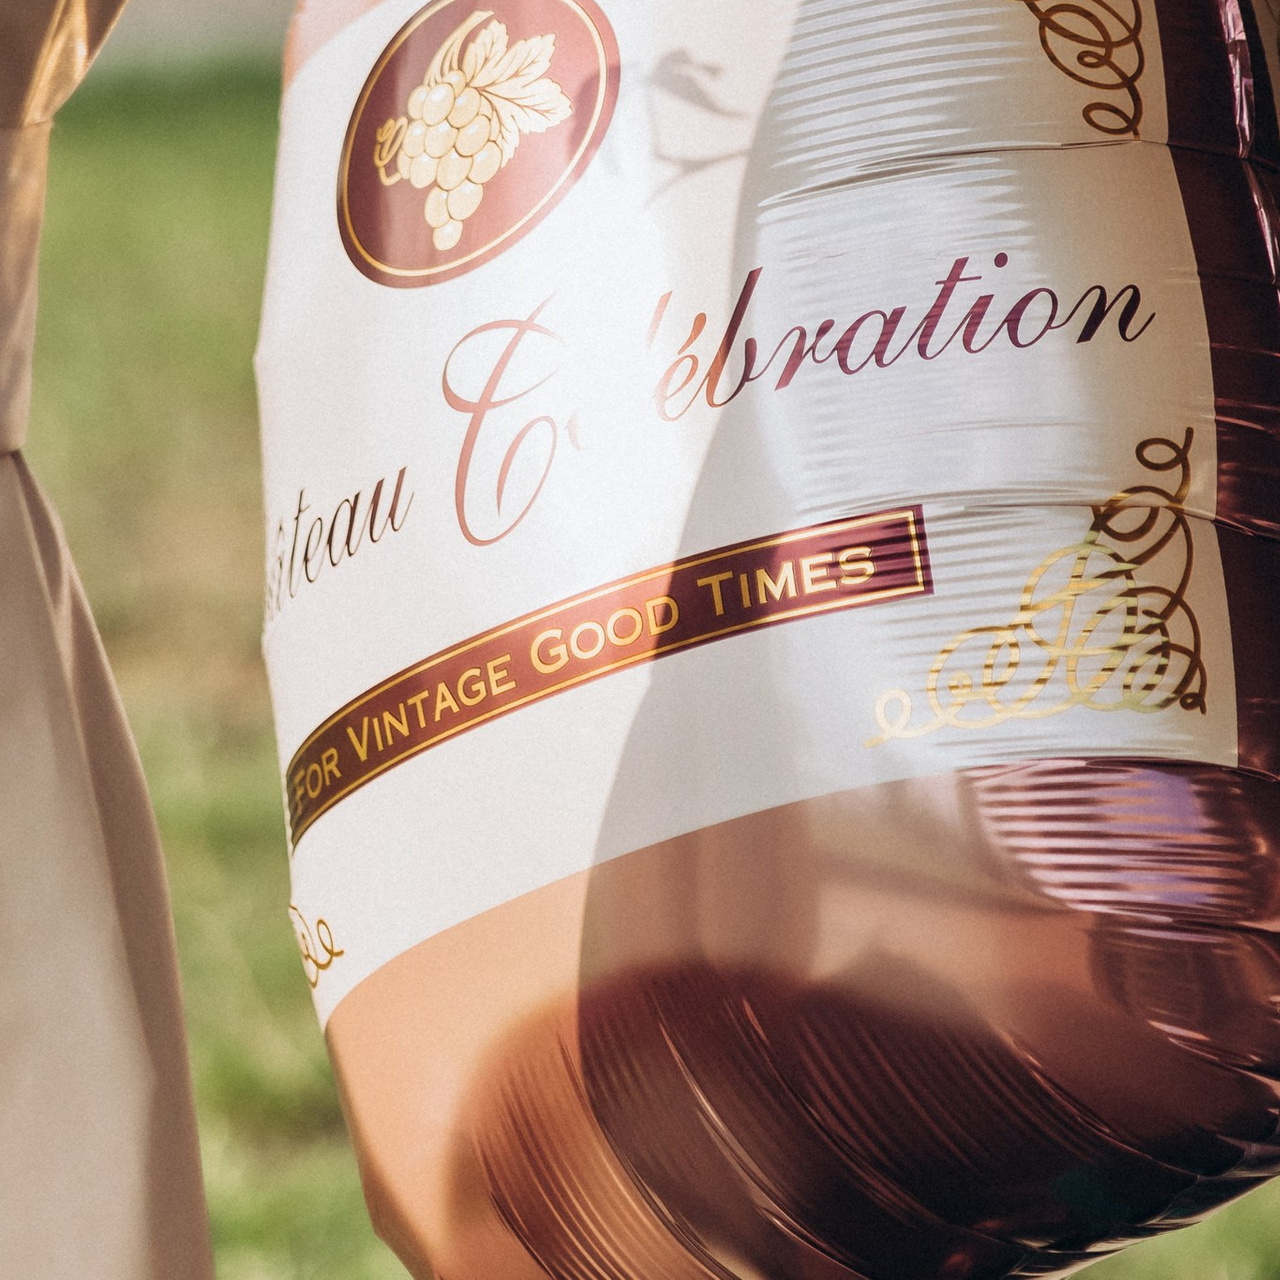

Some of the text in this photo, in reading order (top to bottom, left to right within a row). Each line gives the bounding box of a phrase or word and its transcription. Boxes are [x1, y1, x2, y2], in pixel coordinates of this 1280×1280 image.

[293, 545, 875, 815] FOR VINTAGE GOOD TIMES
